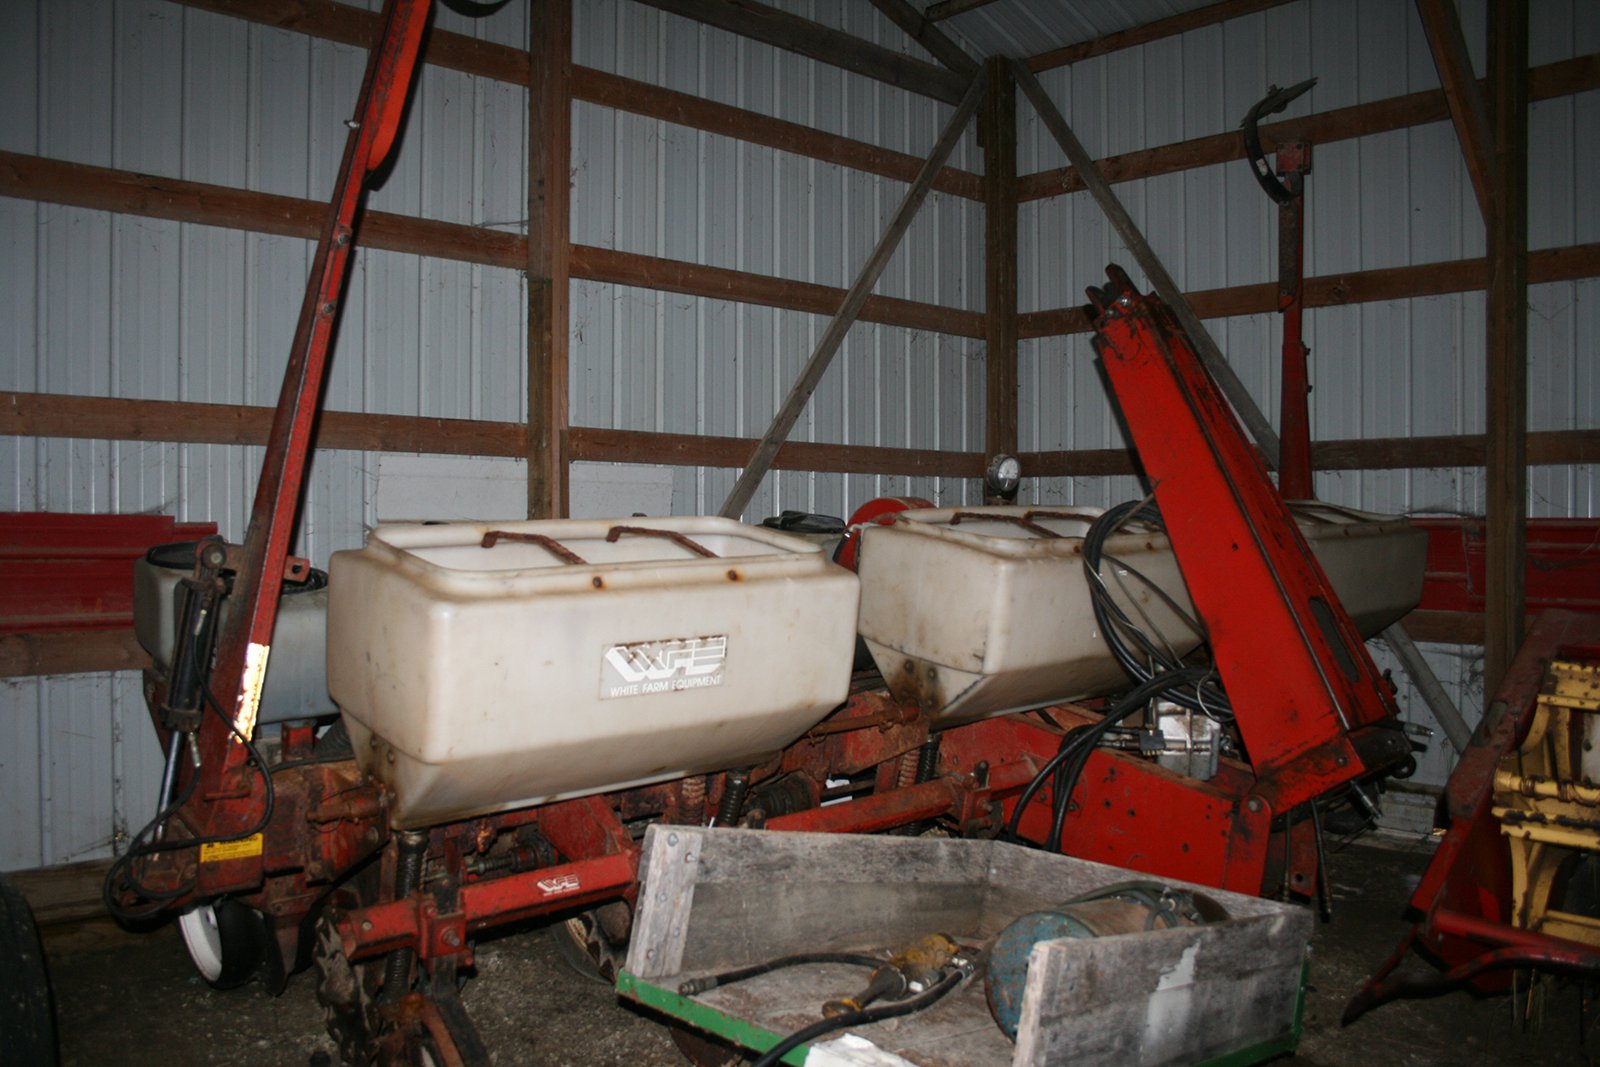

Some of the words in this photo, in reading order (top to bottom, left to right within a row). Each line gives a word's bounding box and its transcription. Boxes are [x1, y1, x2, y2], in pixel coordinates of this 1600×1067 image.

[610, 685, 639, 697] WHITE
[642, 681, 669, 693] FARM
[671, 675, 721, 689] EQUIPMENT
